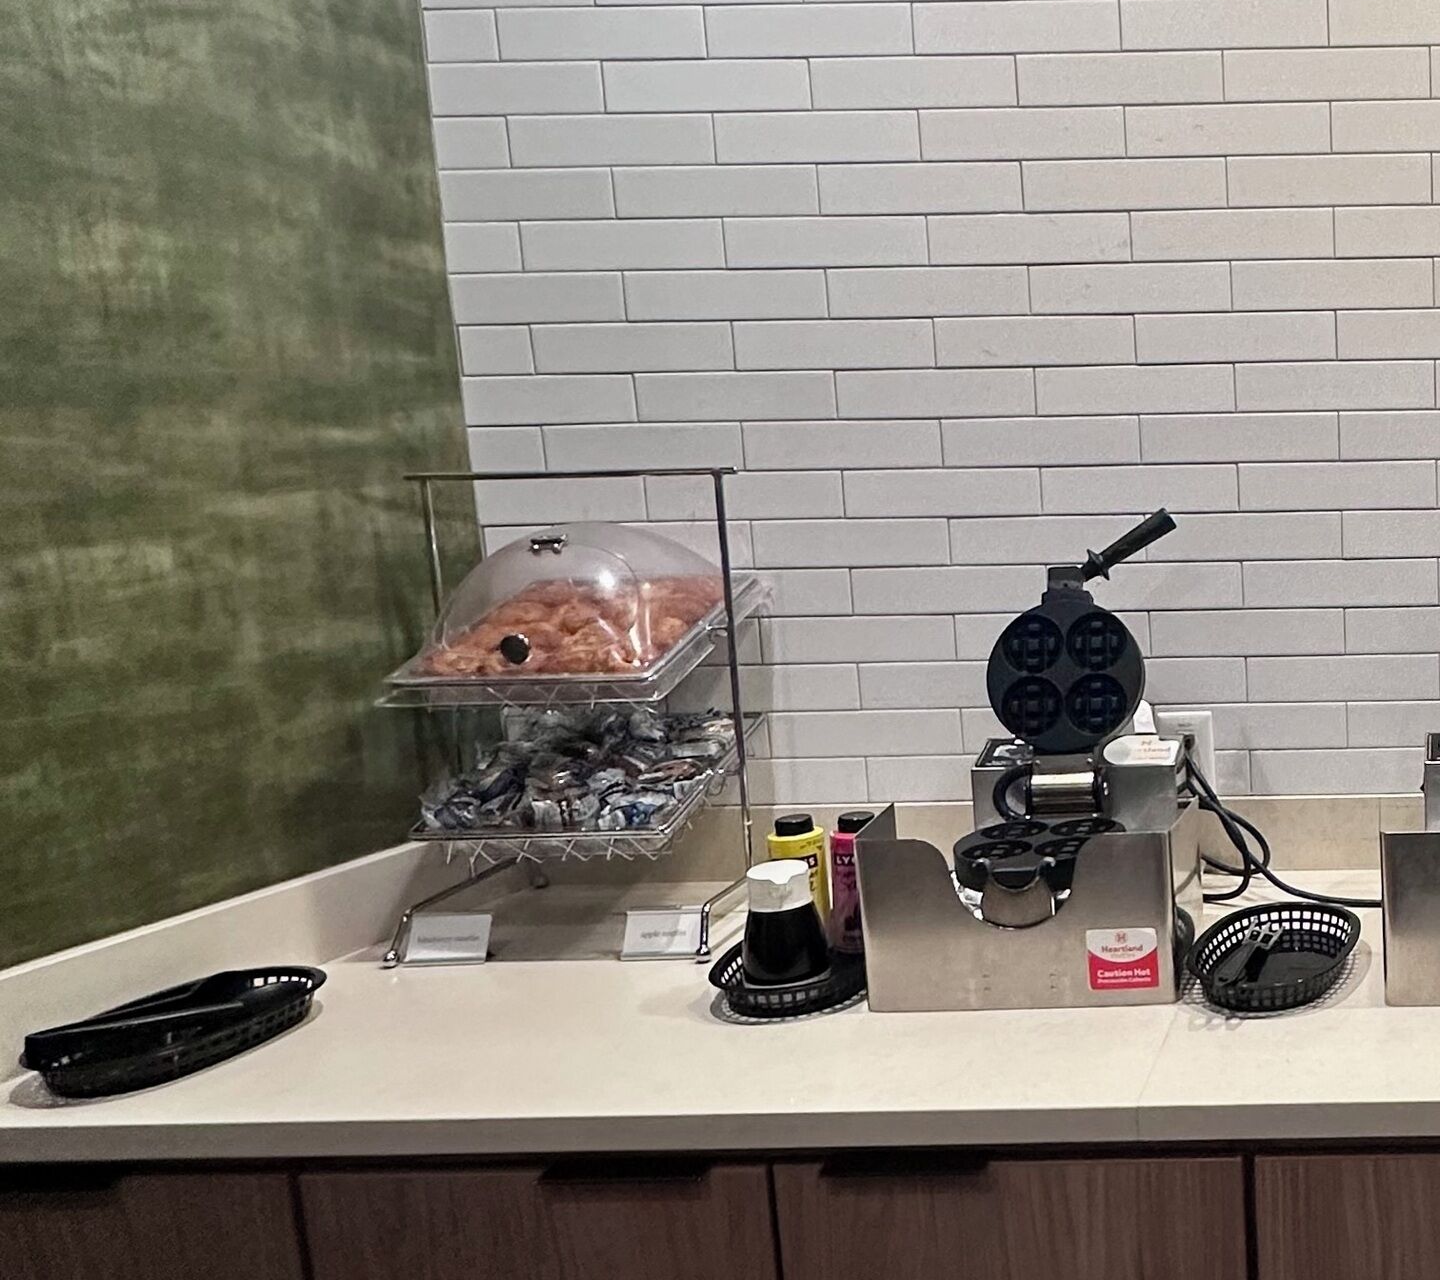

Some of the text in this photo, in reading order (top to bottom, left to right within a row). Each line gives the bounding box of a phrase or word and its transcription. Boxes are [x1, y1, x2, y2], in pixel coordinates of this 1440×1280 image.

[1101, 944, 1144, 953] Heartland
[1096, 968, 1151, 978] Caution Hot
